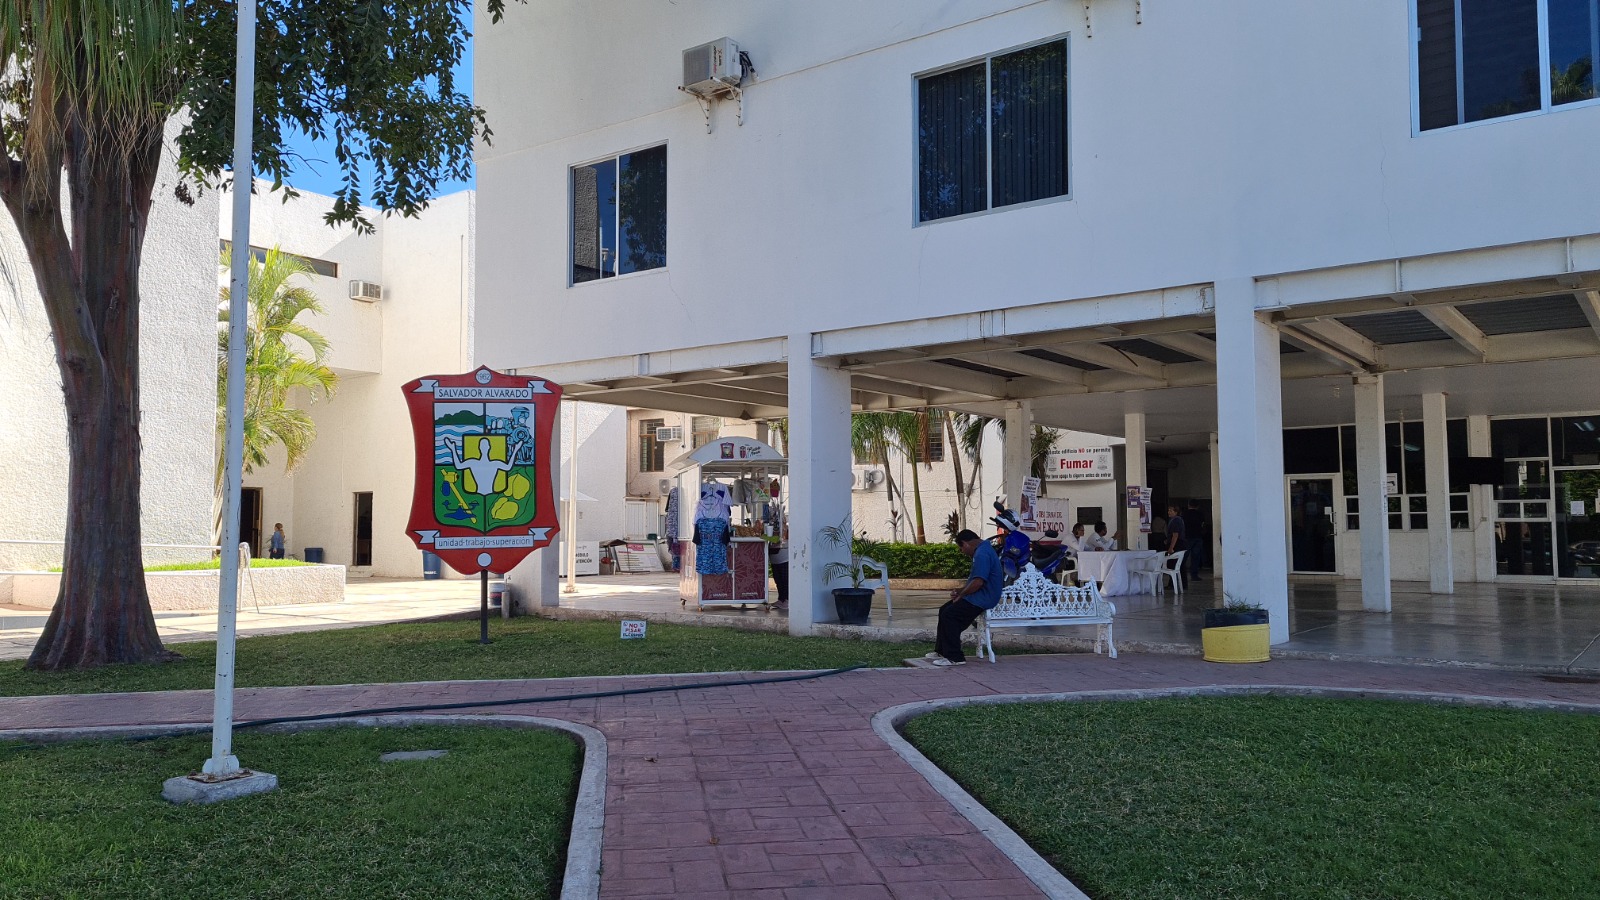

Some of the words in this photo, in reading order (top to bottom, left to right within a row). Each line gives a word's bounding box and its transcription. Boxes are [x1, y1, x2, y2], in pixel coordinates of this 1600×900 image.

[438, 388, 482, 398] SALVADOR
[484, 388, 529, 398] ALVARADO
[1060, 458, 1093, 469] Fumar
